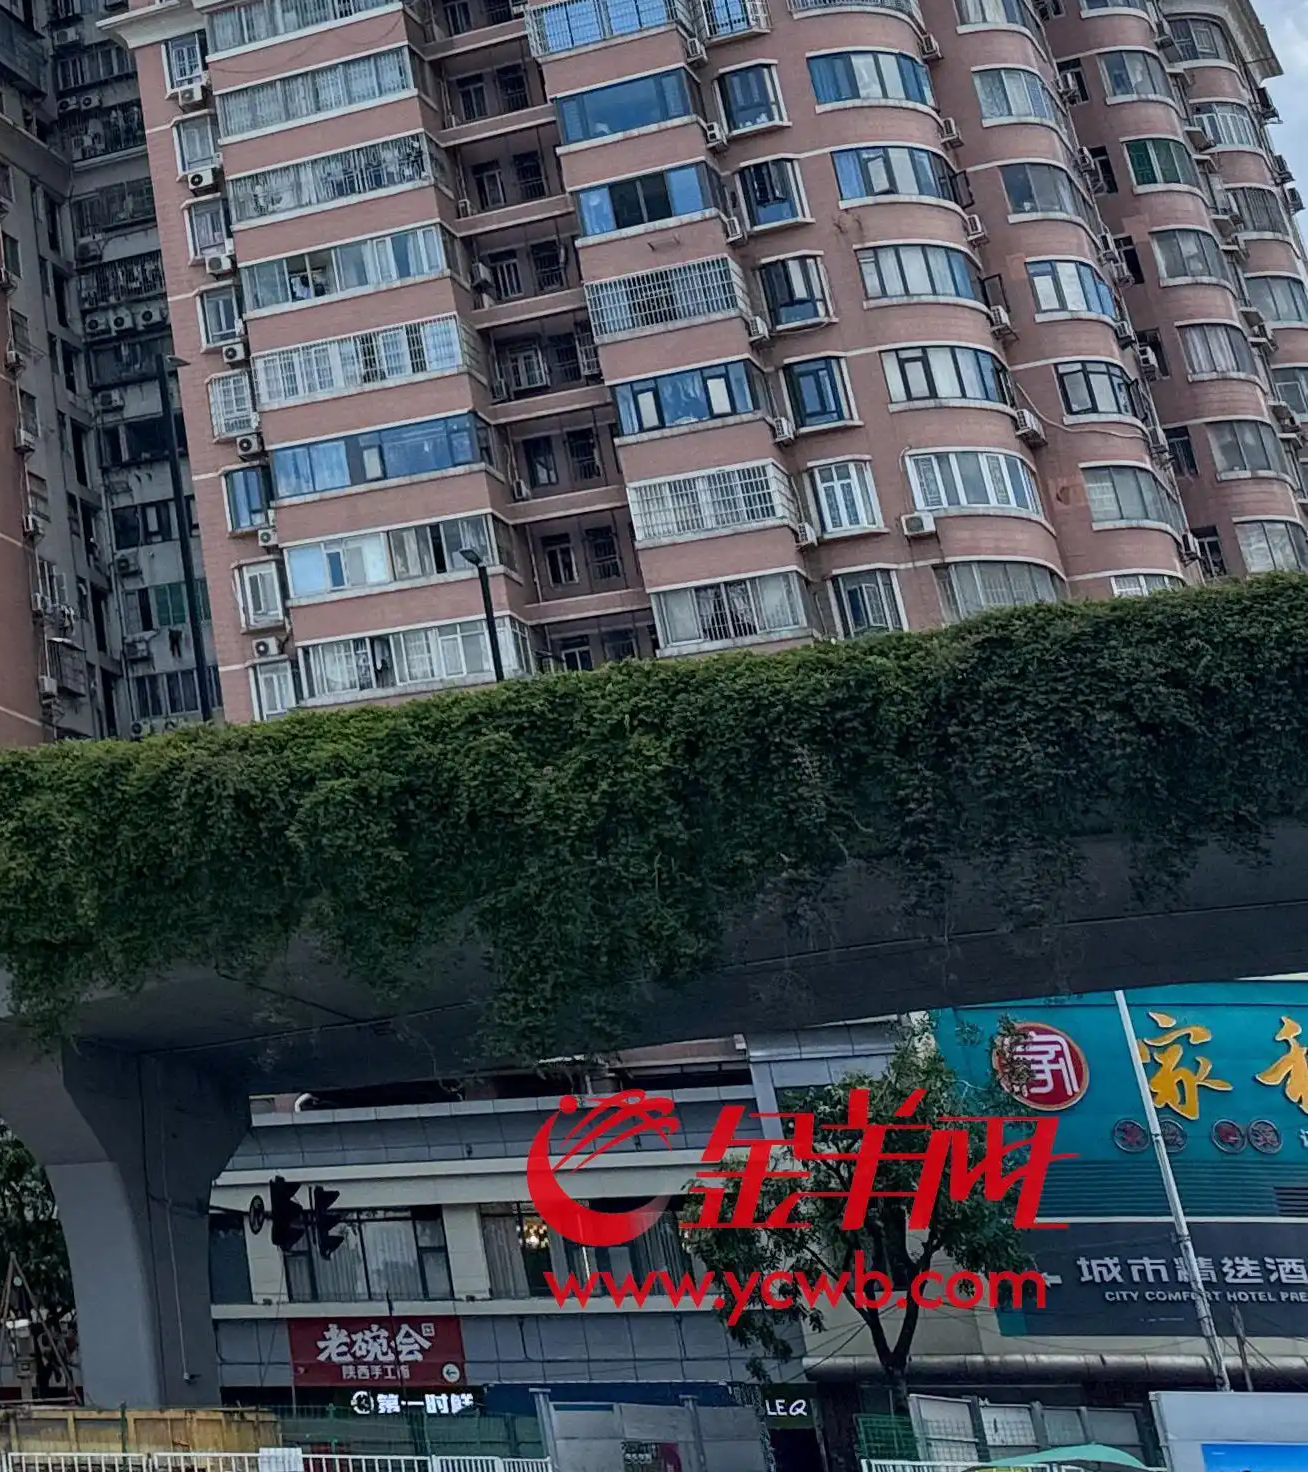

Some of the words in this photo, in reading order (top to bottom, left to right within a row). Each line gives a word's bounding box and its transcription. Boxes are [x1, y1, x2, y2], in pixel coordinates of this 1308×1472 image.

[1105, 1291, 1139, 1302] CITY
[1226, 1291, 1275, 1303] HOTEL
[316, 1323, 432, 1363] 老碗会
